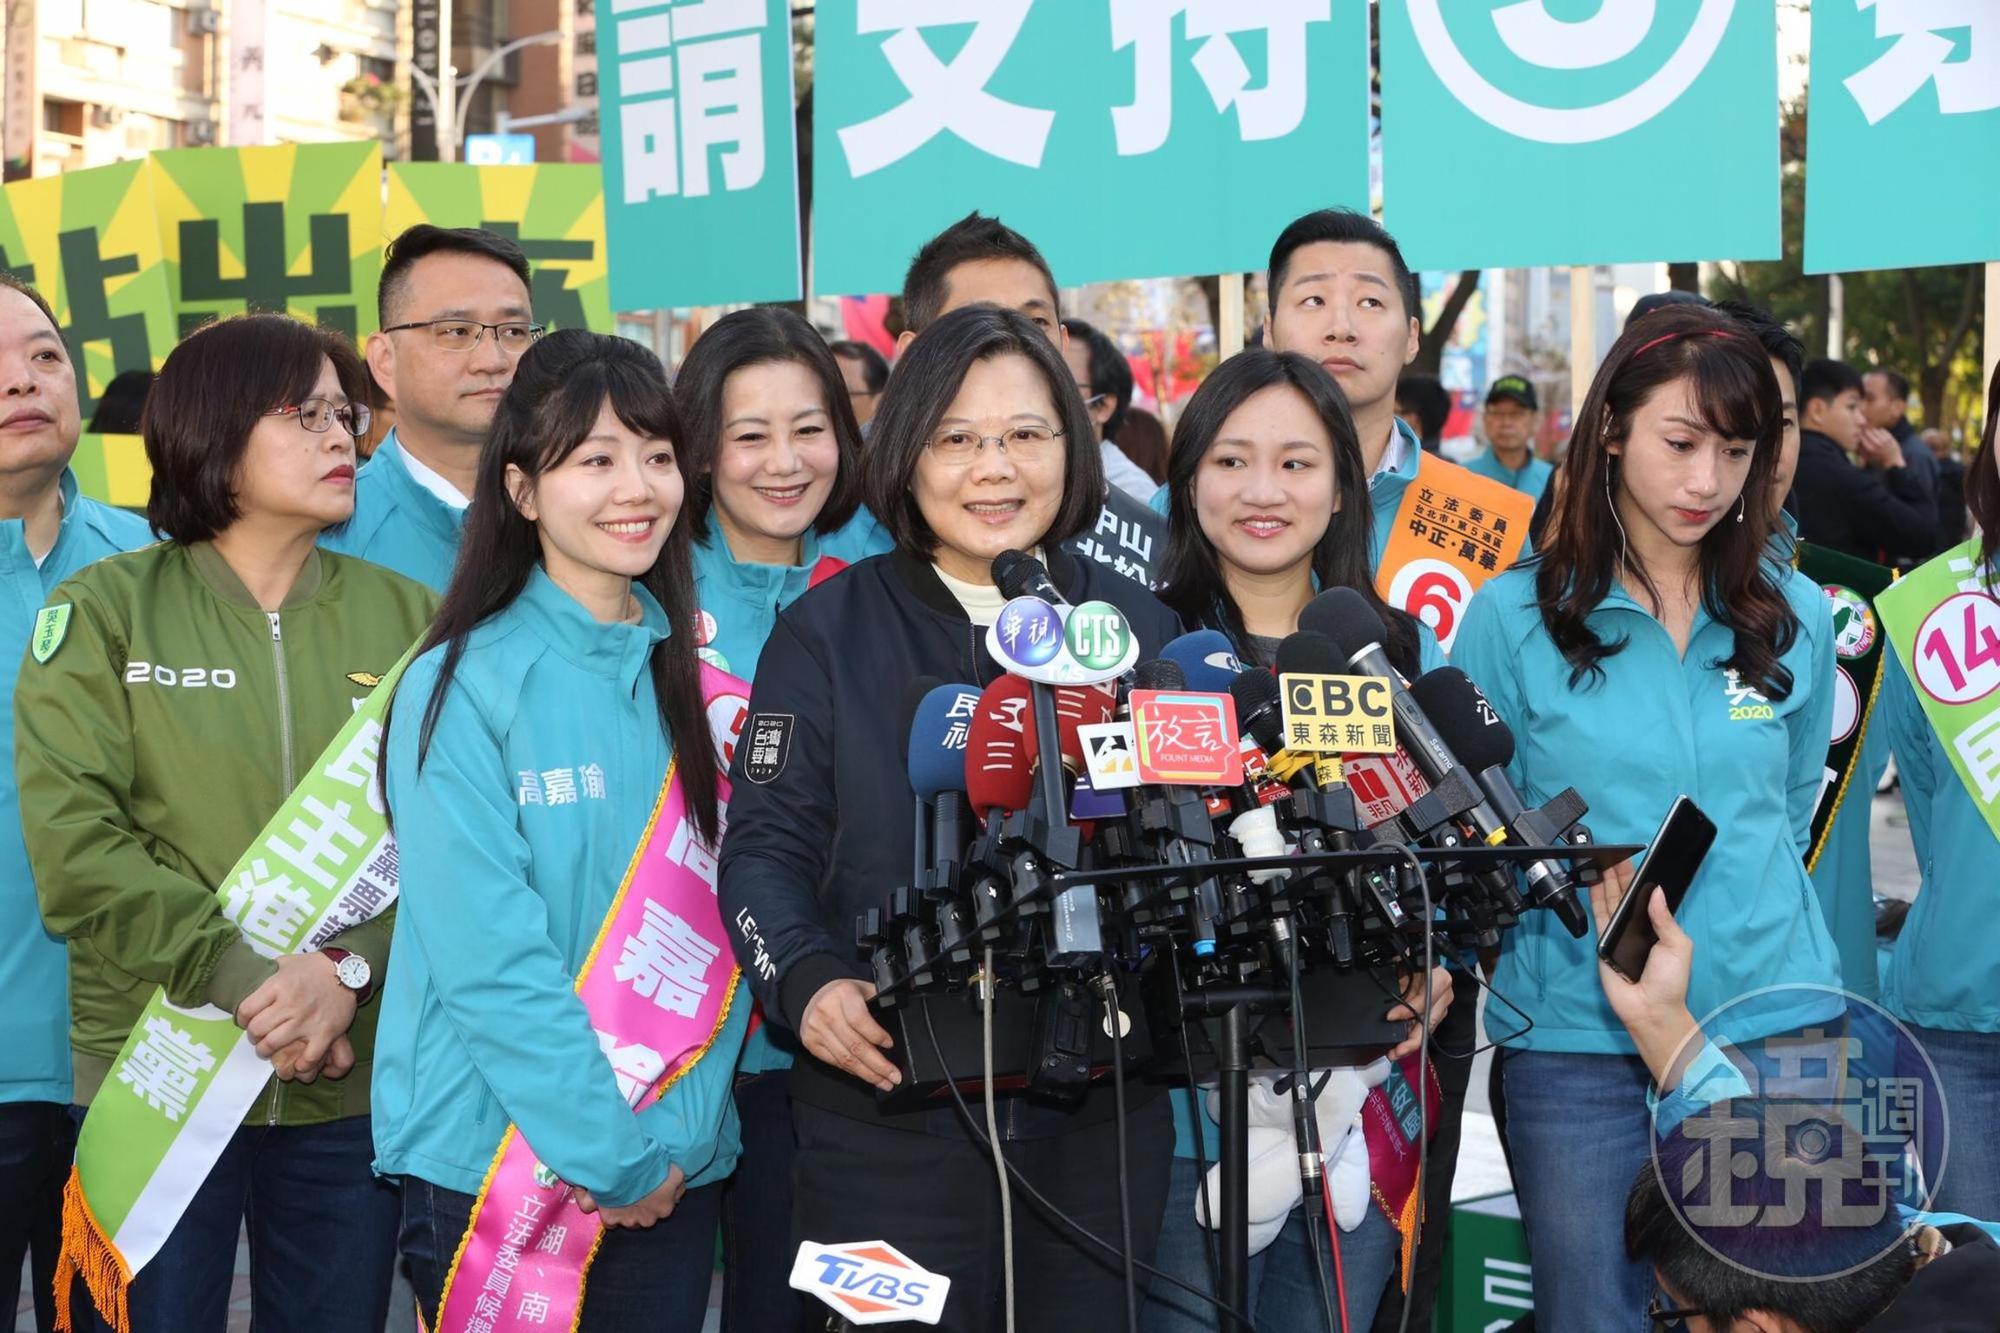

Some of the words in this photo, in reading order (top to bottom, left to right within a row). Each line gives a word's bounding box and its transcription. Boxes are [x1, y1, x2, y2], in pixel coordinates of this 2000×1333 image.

[1418, 487, 1509, 535] 立法委員
[1077, 538, 1169, 591] 北松
[1405, 571, 1462, 642] 6
[1002, 607, 1057, 655] 華視
[1074, 613, 1121, 658] CTS
[1924, 602, 2000, 692] 14
[126, 661, 236, 689] 2020
[1287, 679, 1388, 718] EBC
[1728, 705, 1776, 721] 2020
[1137, 706, 1223, 753] 放言
[1291, 722, 1393, 747] 東森新聞
[1161, 752, 1188, 763] FOUNT
[1190, 754, 1215, 764] MEDIA
[518, 763, 607, 807] 高嘉瑜
[1367, 799, 1399, 819] 非凡
[815, 1253, 930, 1307] TVBS
